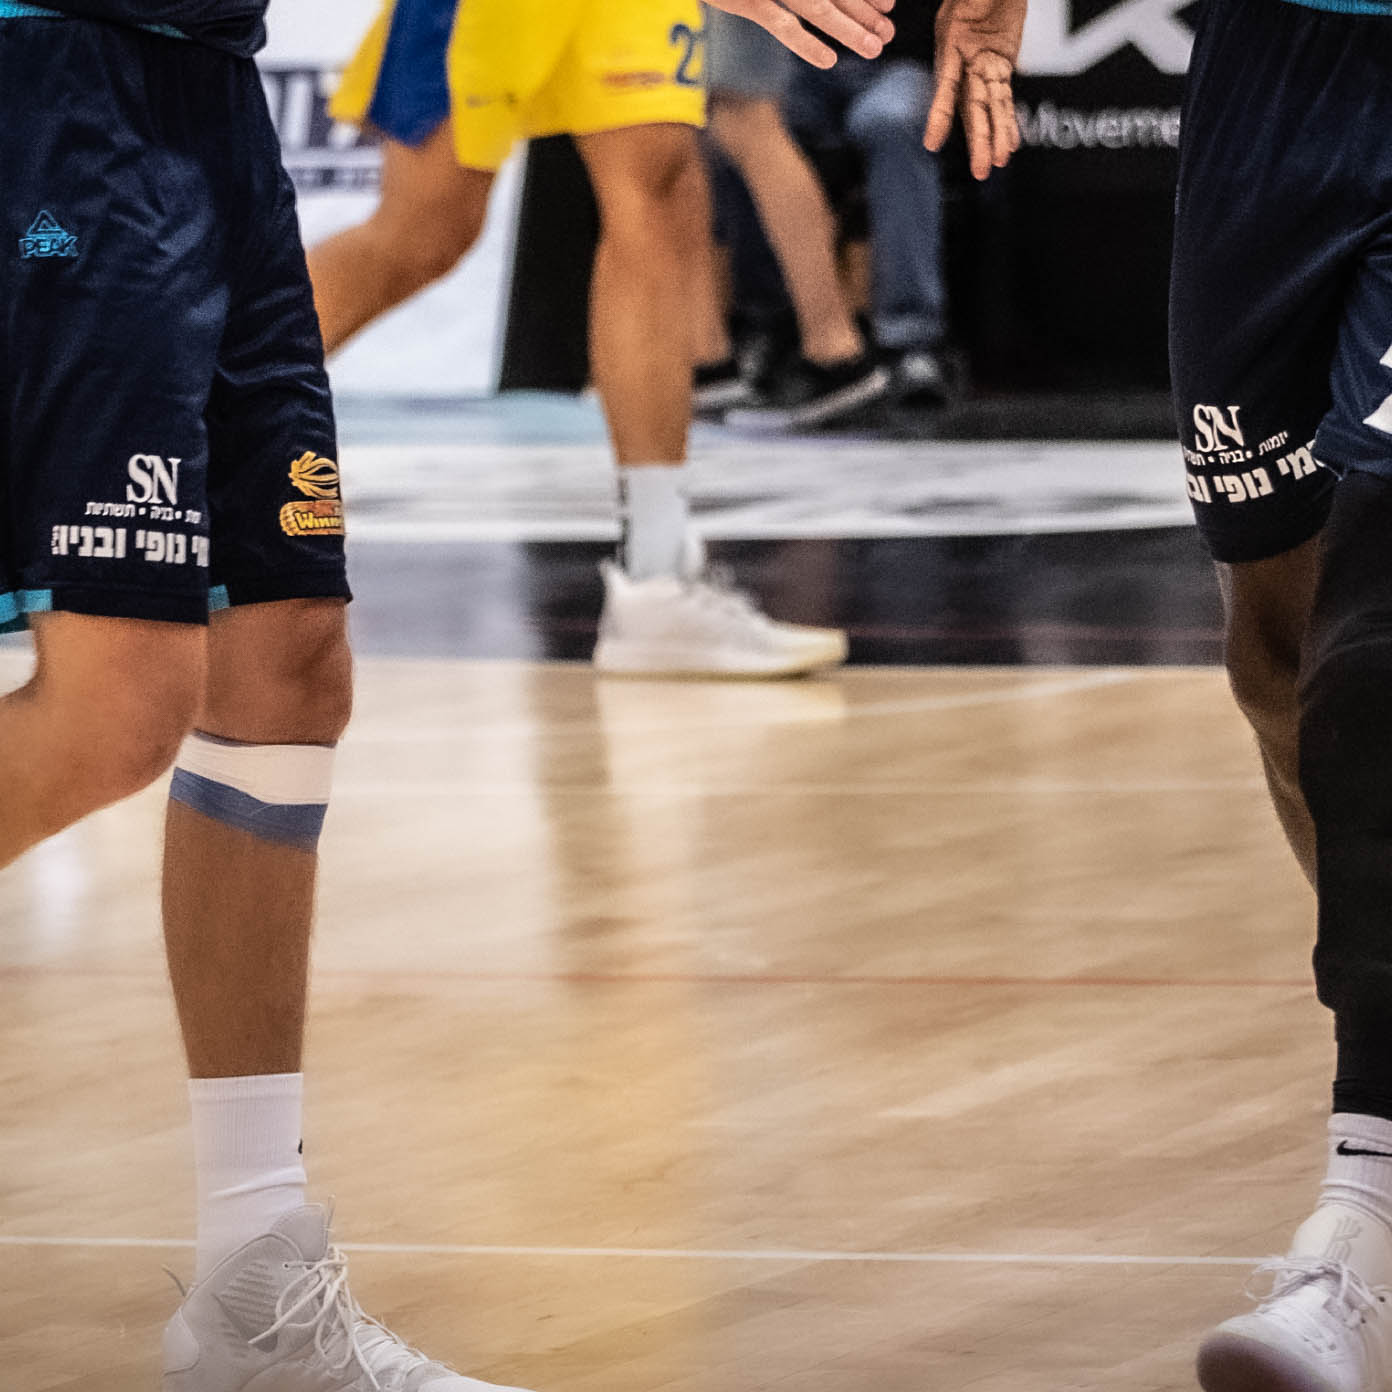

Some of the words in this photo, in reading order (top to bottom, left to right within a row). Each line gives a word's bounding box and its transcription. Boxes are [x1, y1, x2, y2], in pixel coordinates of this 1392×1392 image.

[671, 23, 706, 86] 2
[1193, 403, 1245, 453] SN
[1258, 429, 1289, 456] יזמות
[1218, 449, 1246, 465] בניה
[126, 453, 182, 506] SN
[1212, 467, 1275, 504] נופי
[134, 529, 187, 565] נופי
